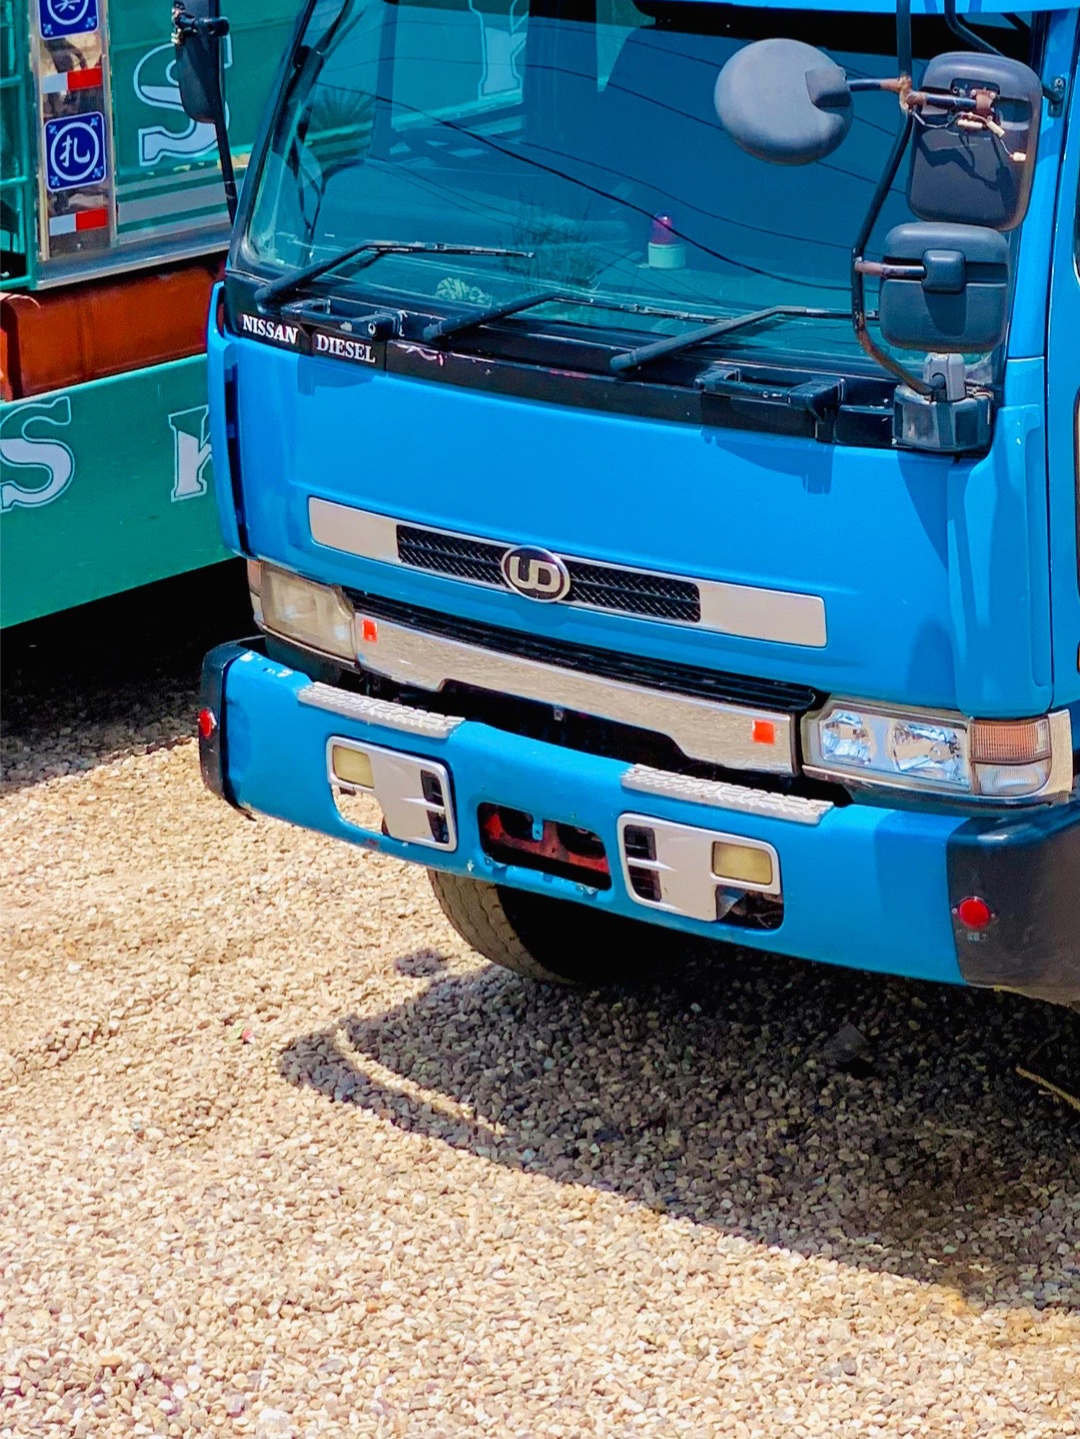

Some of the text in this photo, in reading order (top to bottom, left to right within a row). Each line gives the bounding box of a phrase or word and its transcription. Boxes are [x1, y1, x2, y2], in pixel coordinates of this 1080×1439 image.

[59, 134, 91, 168] 扎
[241, 313, 377, 364] NISSAN DIESEL
[509, 555, 561, 593] UD
